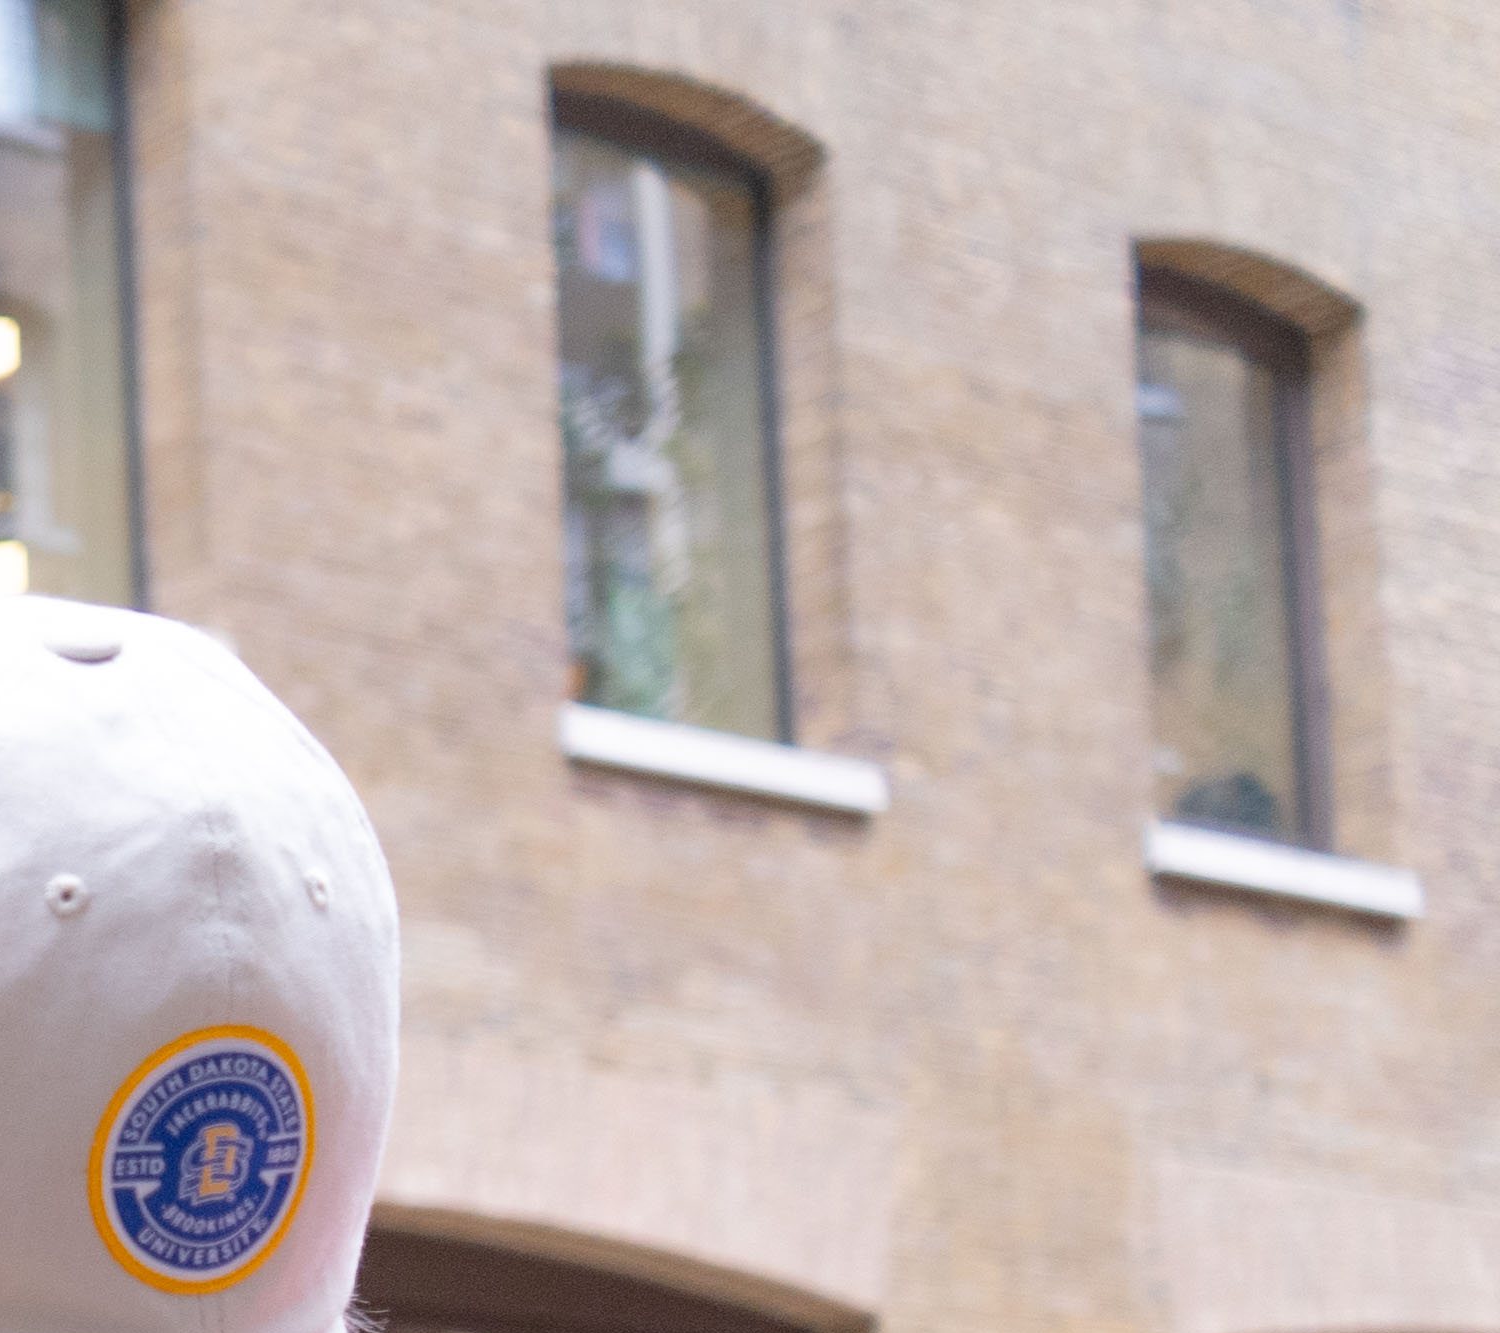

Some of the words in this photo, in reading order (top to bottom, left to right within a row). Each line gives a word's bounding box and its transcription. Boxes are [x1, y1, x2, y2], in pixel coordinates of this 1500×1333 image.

[122, 1073, 184, 1144] SOUTH
[189, 1057, 269, 1084] DAKOTA
[270, 1076, 299, 1131] STATE
[115, 1157, 166, 1178] ESTD
[138, 1219, 267, 1266] UNIVERSITY
